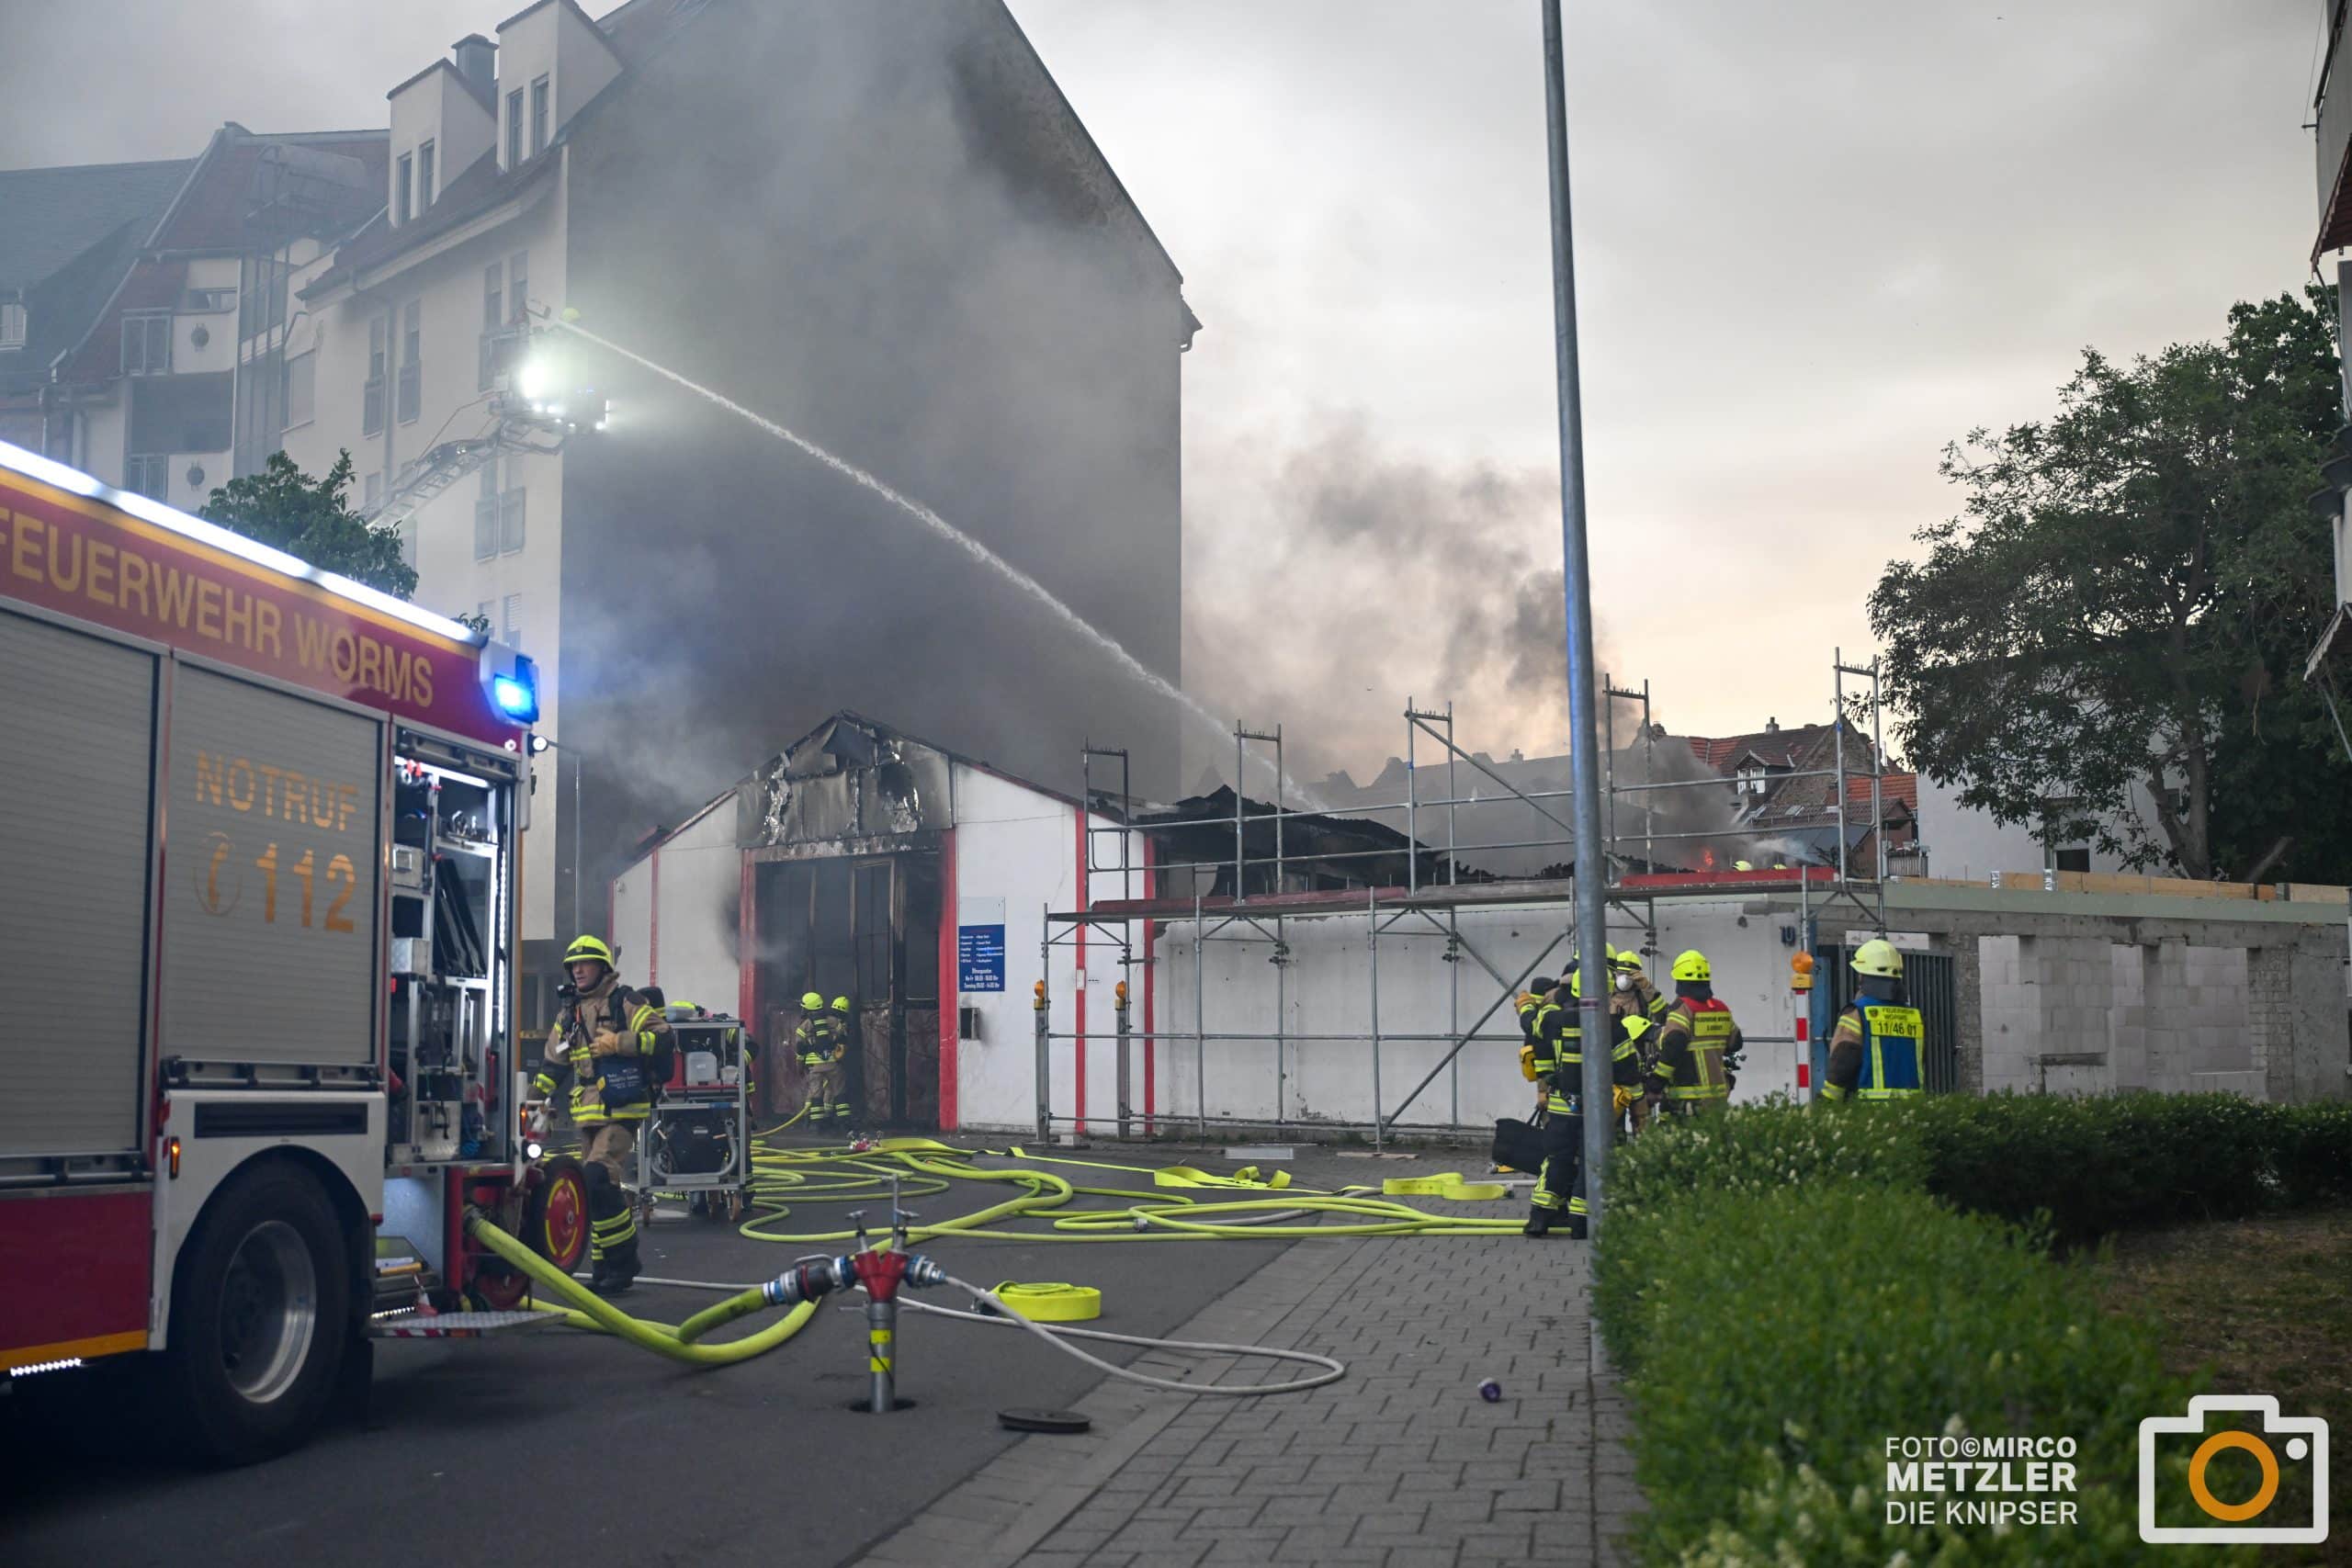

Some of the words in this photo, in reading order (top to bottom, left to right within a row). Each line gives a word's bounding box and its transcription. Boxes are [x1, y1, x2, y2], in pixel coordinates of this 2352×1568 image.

[293, 611, 434, 707] WORMS
[196, 749, 359, 831] NOTRUF
[255, 841, 355, 933] 112
